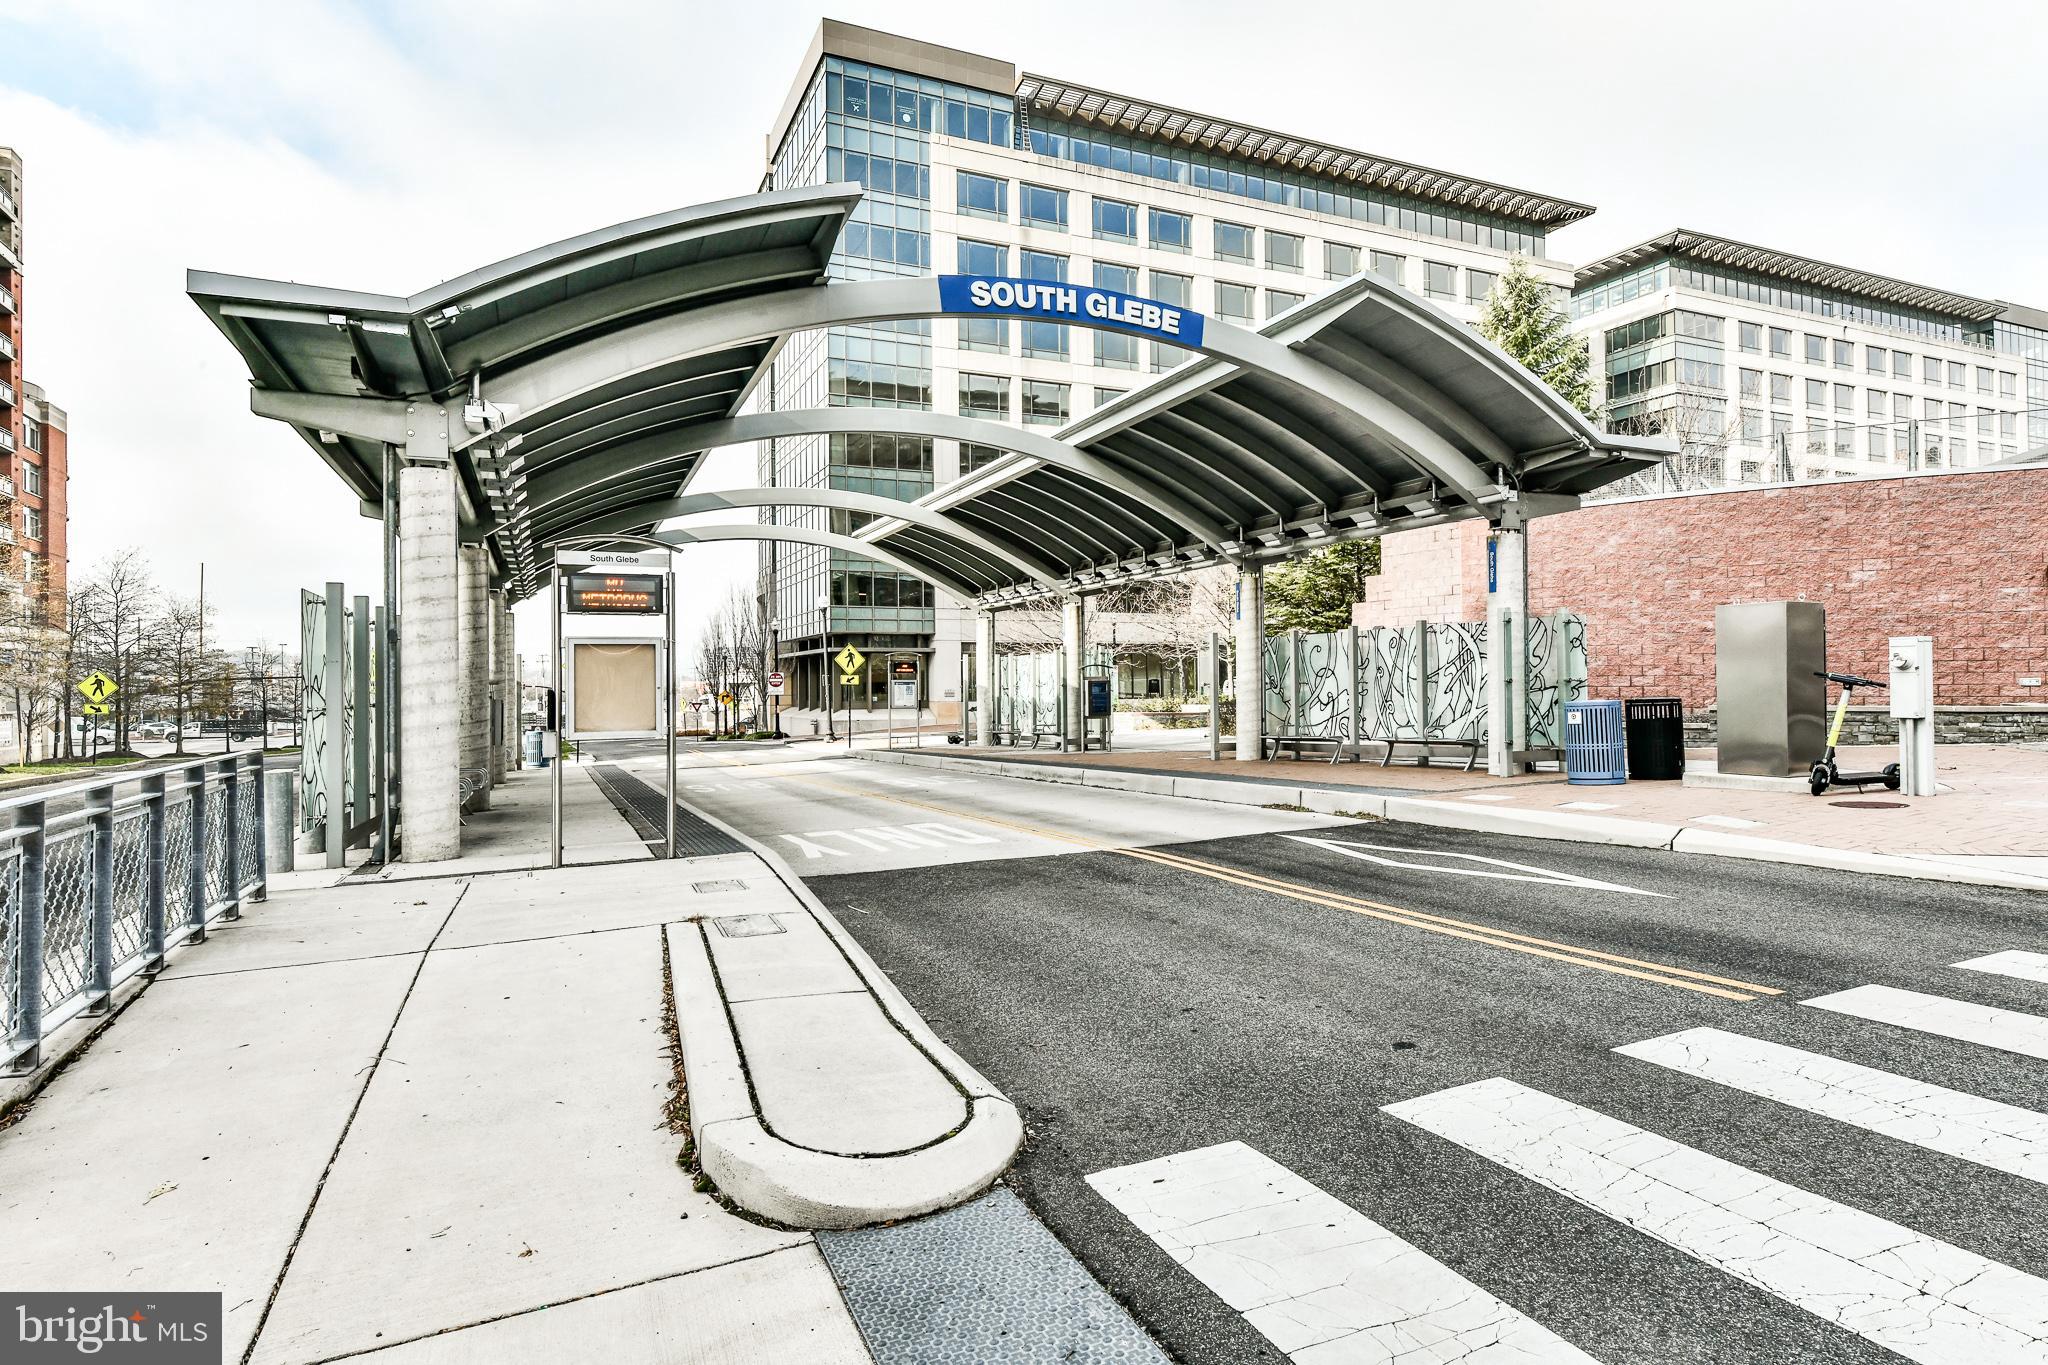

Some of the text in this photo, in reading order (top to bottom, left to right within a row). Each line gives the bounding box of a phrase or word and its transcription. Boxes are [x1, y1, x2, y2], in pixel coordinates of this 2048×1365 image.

[970, 280, 1181, 335] SOUTH GLEBE
[590, 554, 639, 563] South Glebe
[778, 822, 1001, 859] ONLY
